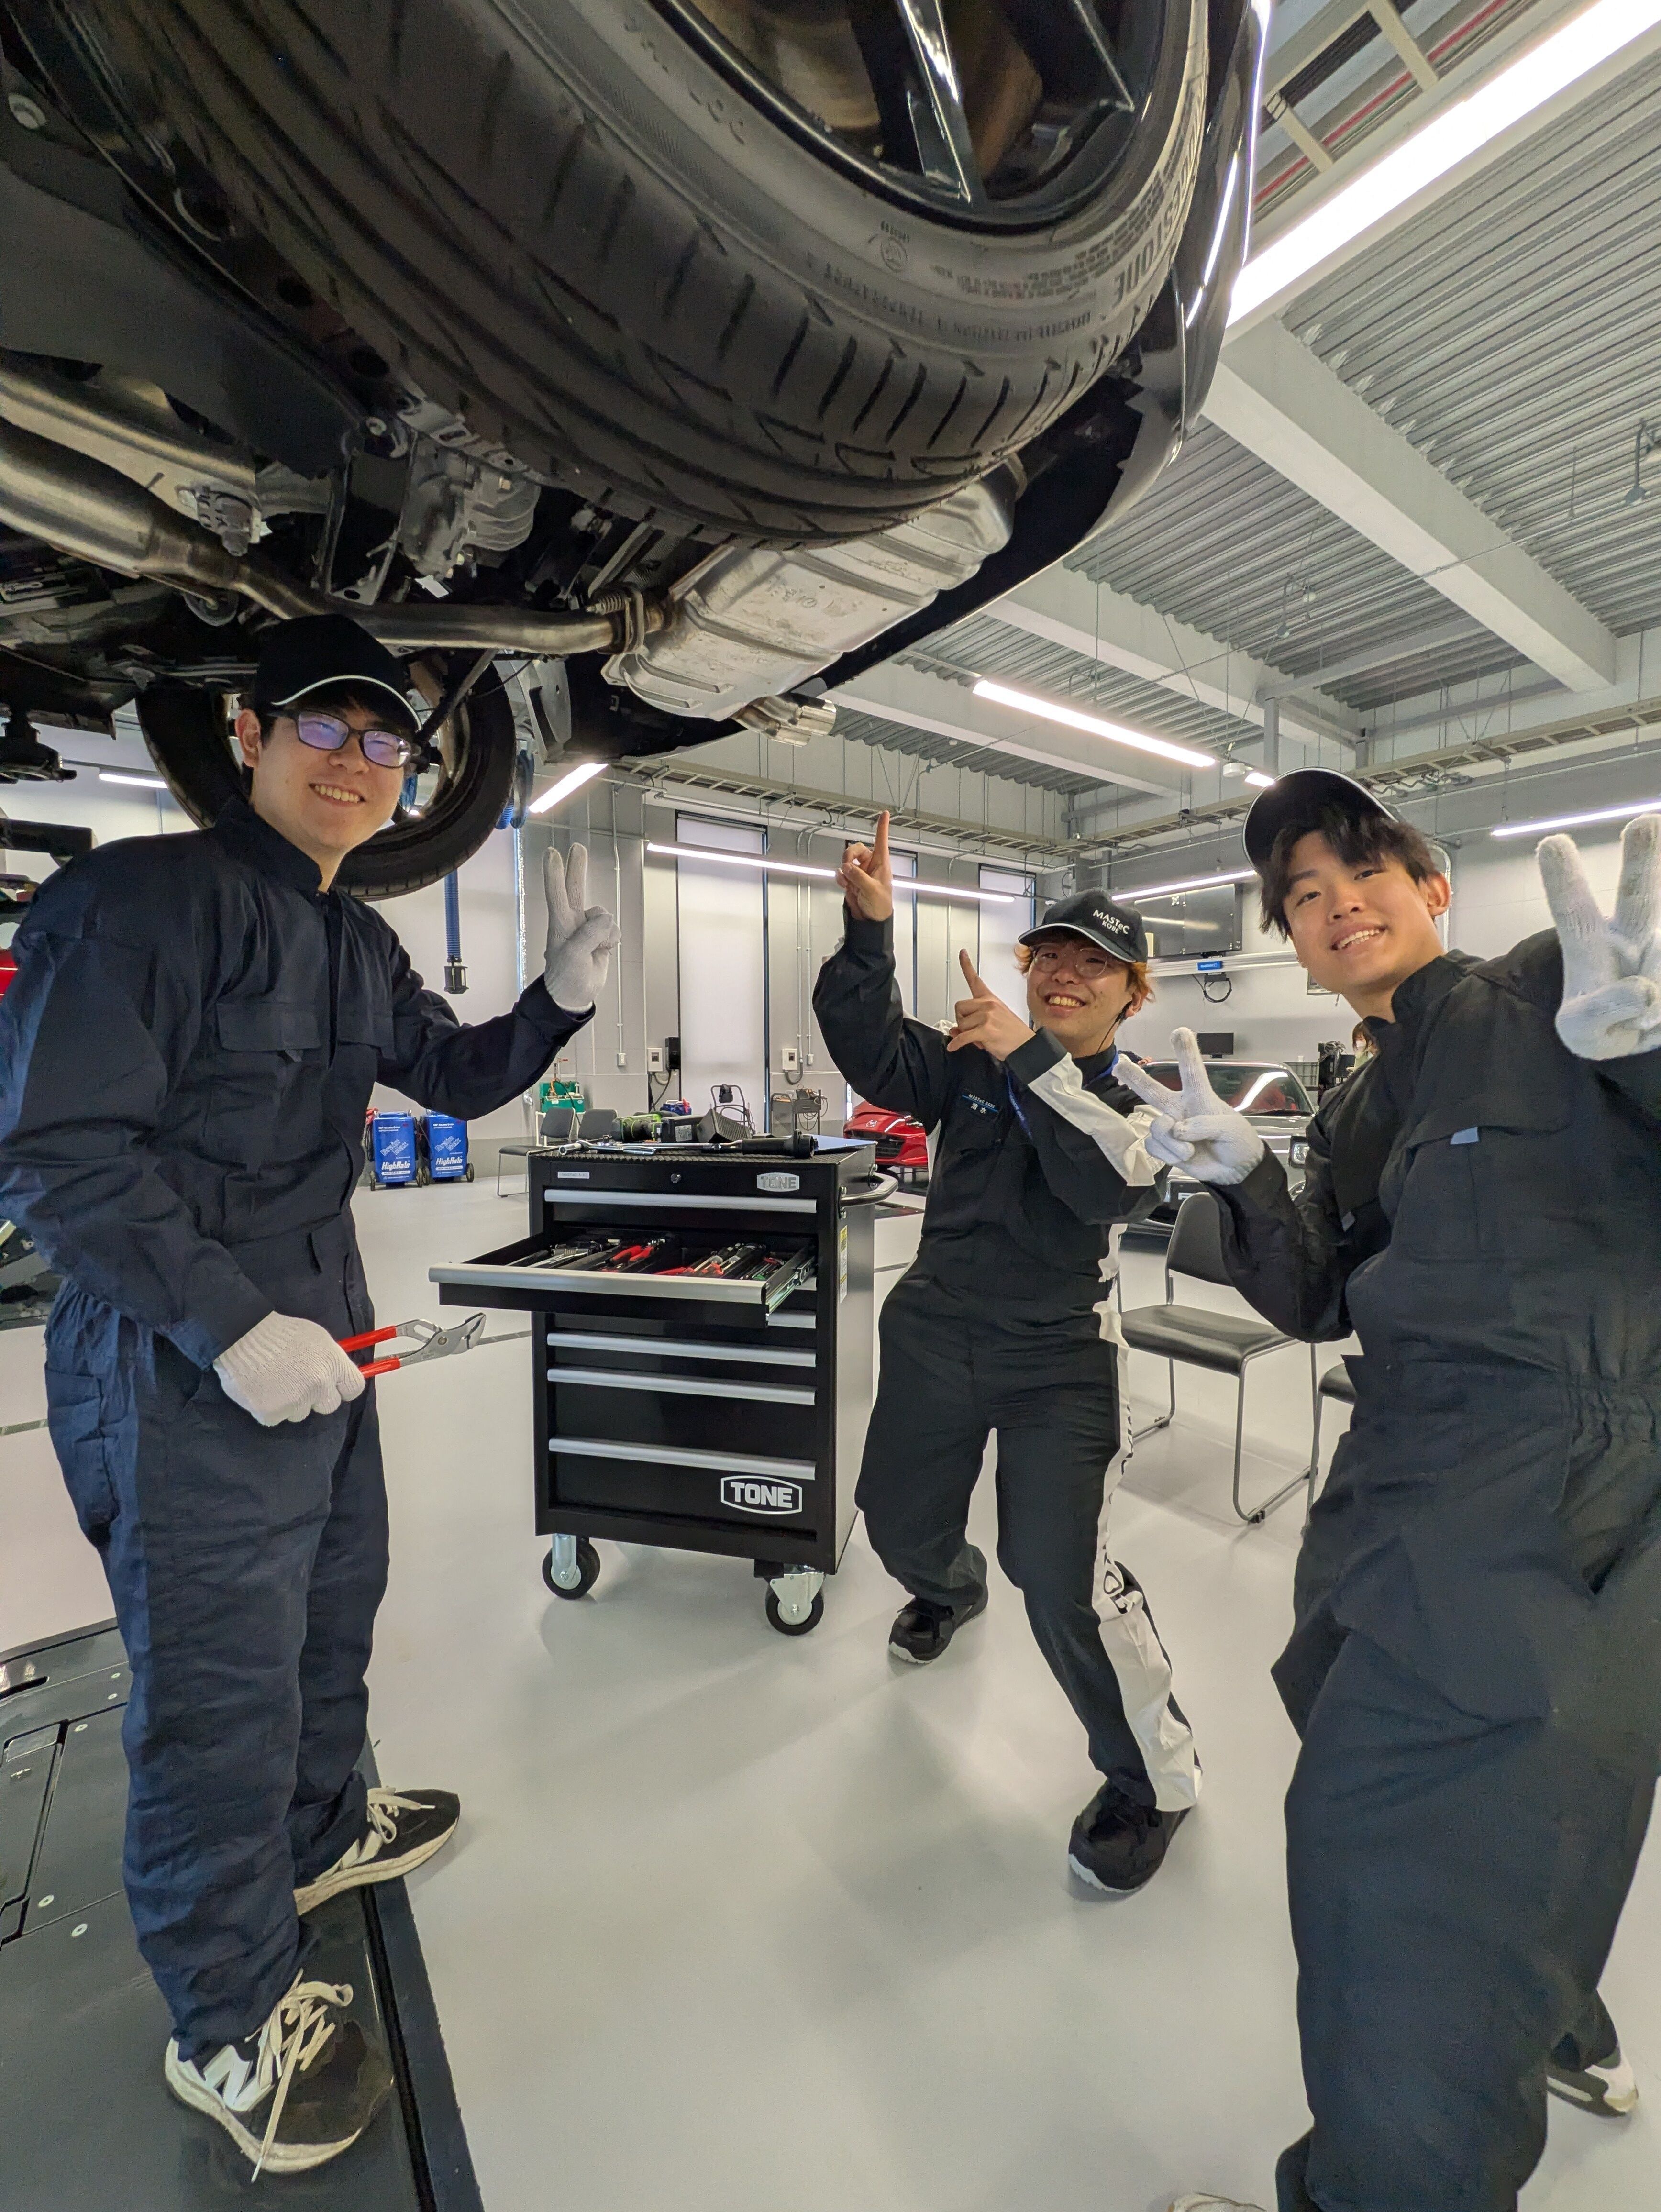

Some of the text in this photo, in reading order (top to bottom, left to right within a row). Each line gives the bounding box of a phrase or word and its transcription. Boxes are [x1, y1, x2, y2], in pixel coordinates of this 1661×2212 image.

[1102, 920, 1119, 934] KOBE
[761, 1176, 796, 1189] TONE
[731, 1482, 792, 1508] TONE
